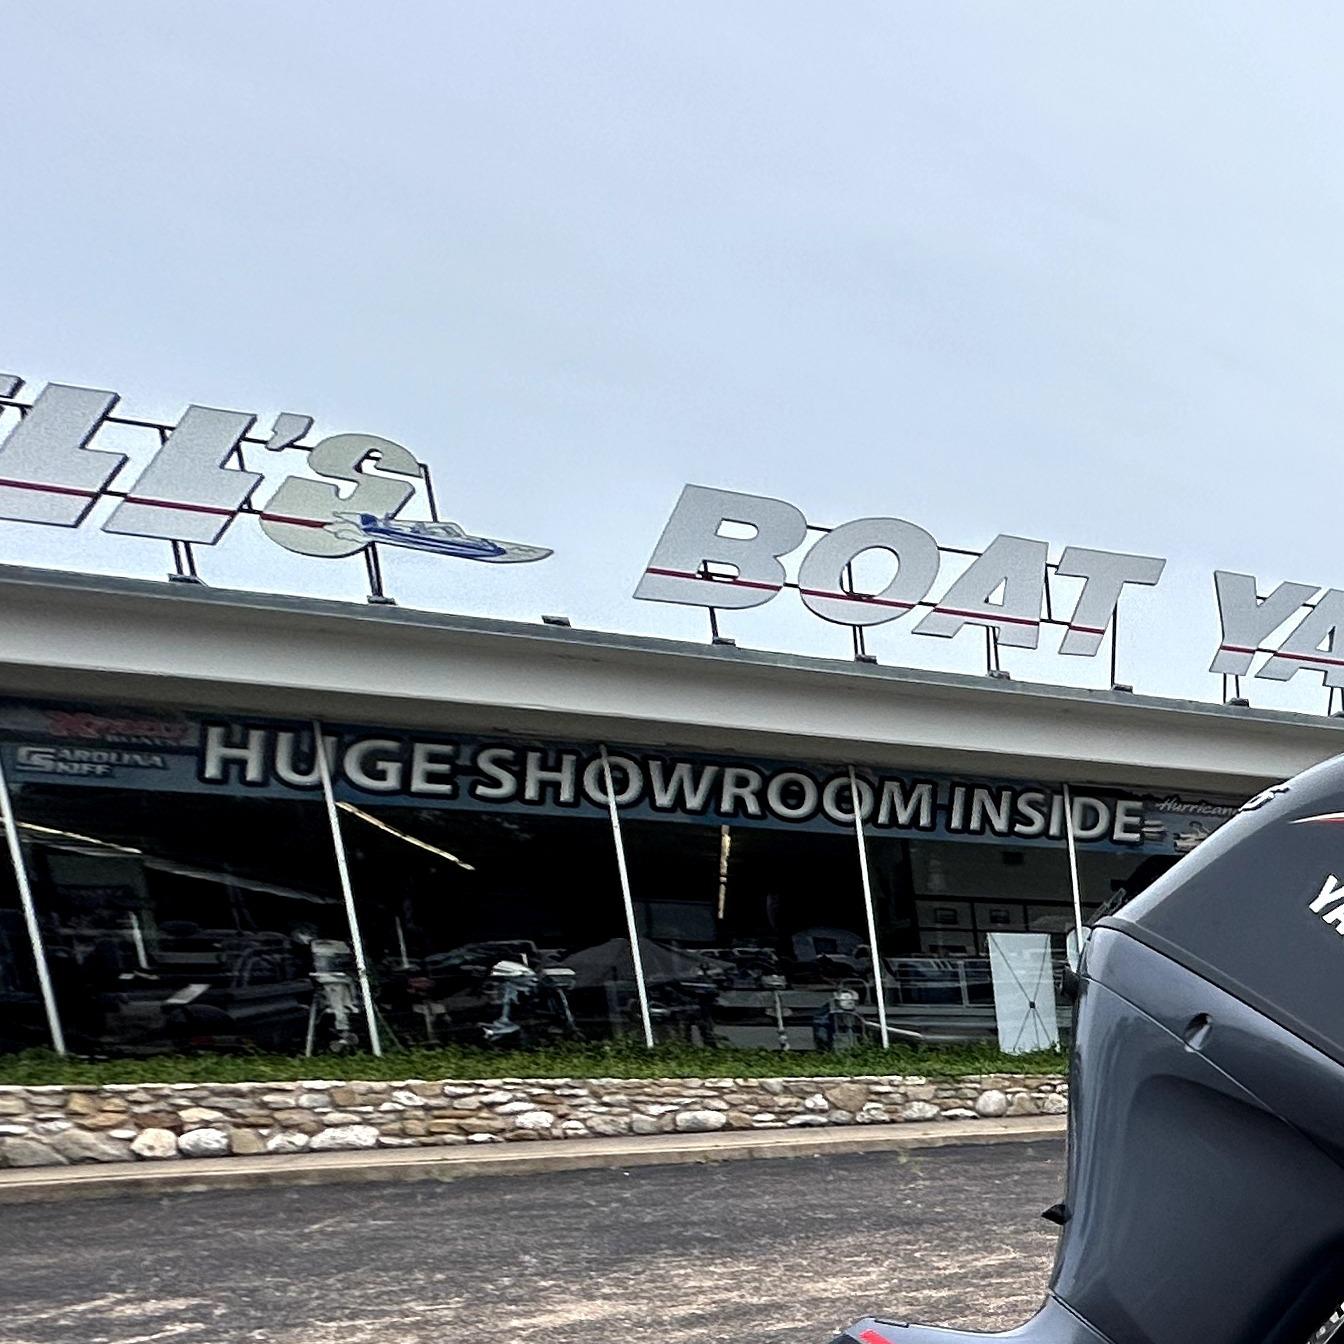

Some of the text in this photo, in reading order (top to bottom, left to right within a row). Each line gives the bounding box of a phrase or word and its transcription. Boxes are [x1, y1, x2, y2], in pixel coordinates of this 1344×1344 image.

[0, 373, 424, 559] LL'S
[633, 484, 1166, 656] BOAT
[204, 726, 1144, 842] HUGE SHOWROOM INSIDE
